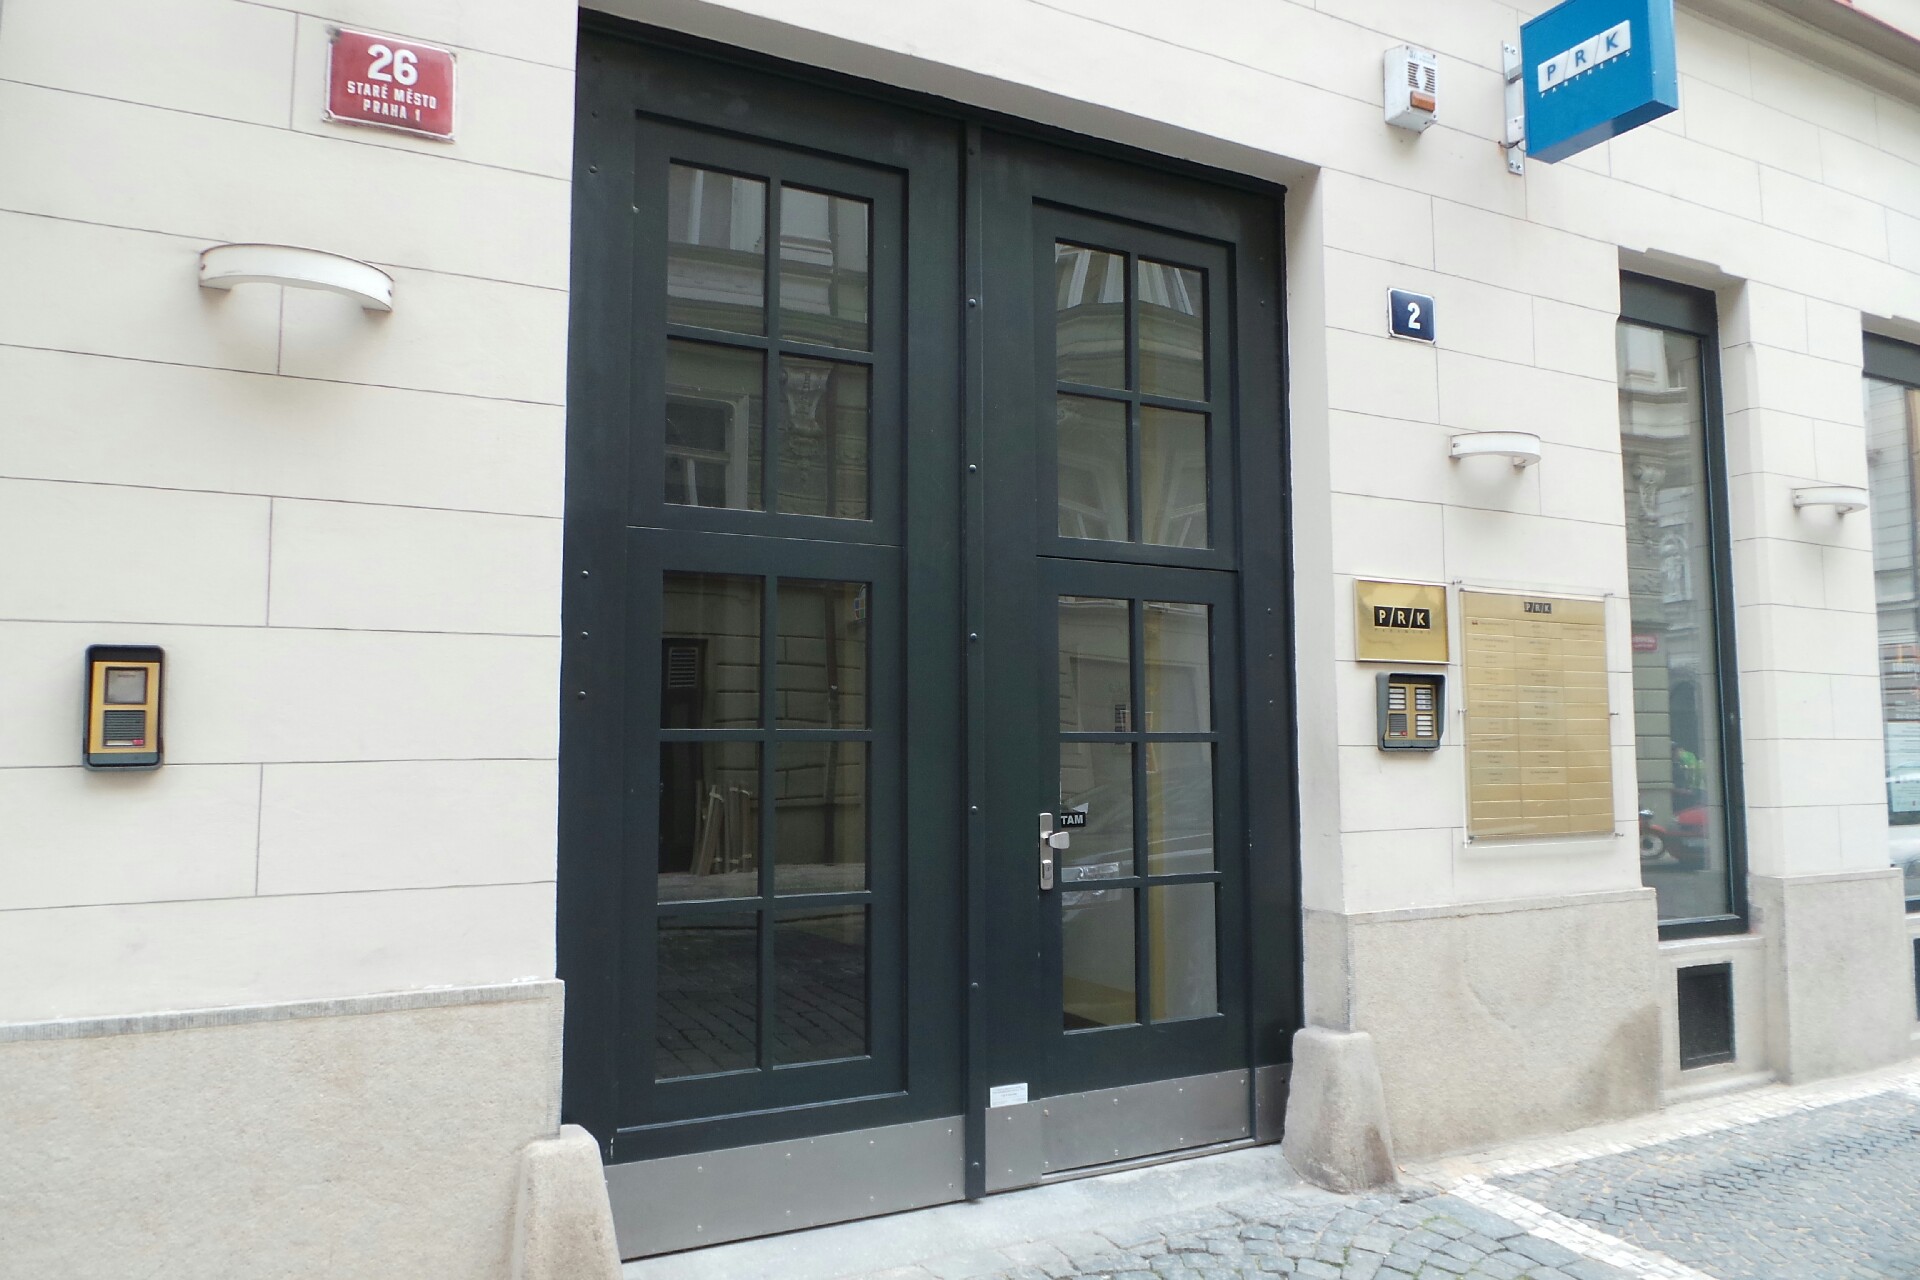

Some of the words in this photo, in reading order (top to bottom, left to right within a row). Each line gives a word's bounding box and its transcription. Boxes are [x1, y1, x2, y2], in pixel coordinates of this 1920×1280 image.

[367, 44, 418, 86] 26
[347, 81, 388, 98] STARÉ
[394, 88, 437, 109] MĚSTO
[363, 99, 407, 119] PRAHA
[415, 109, 421, 121] 1
[1407, 302, 1420, 330] 2
[1060, 814, 1084, 825] TAM
